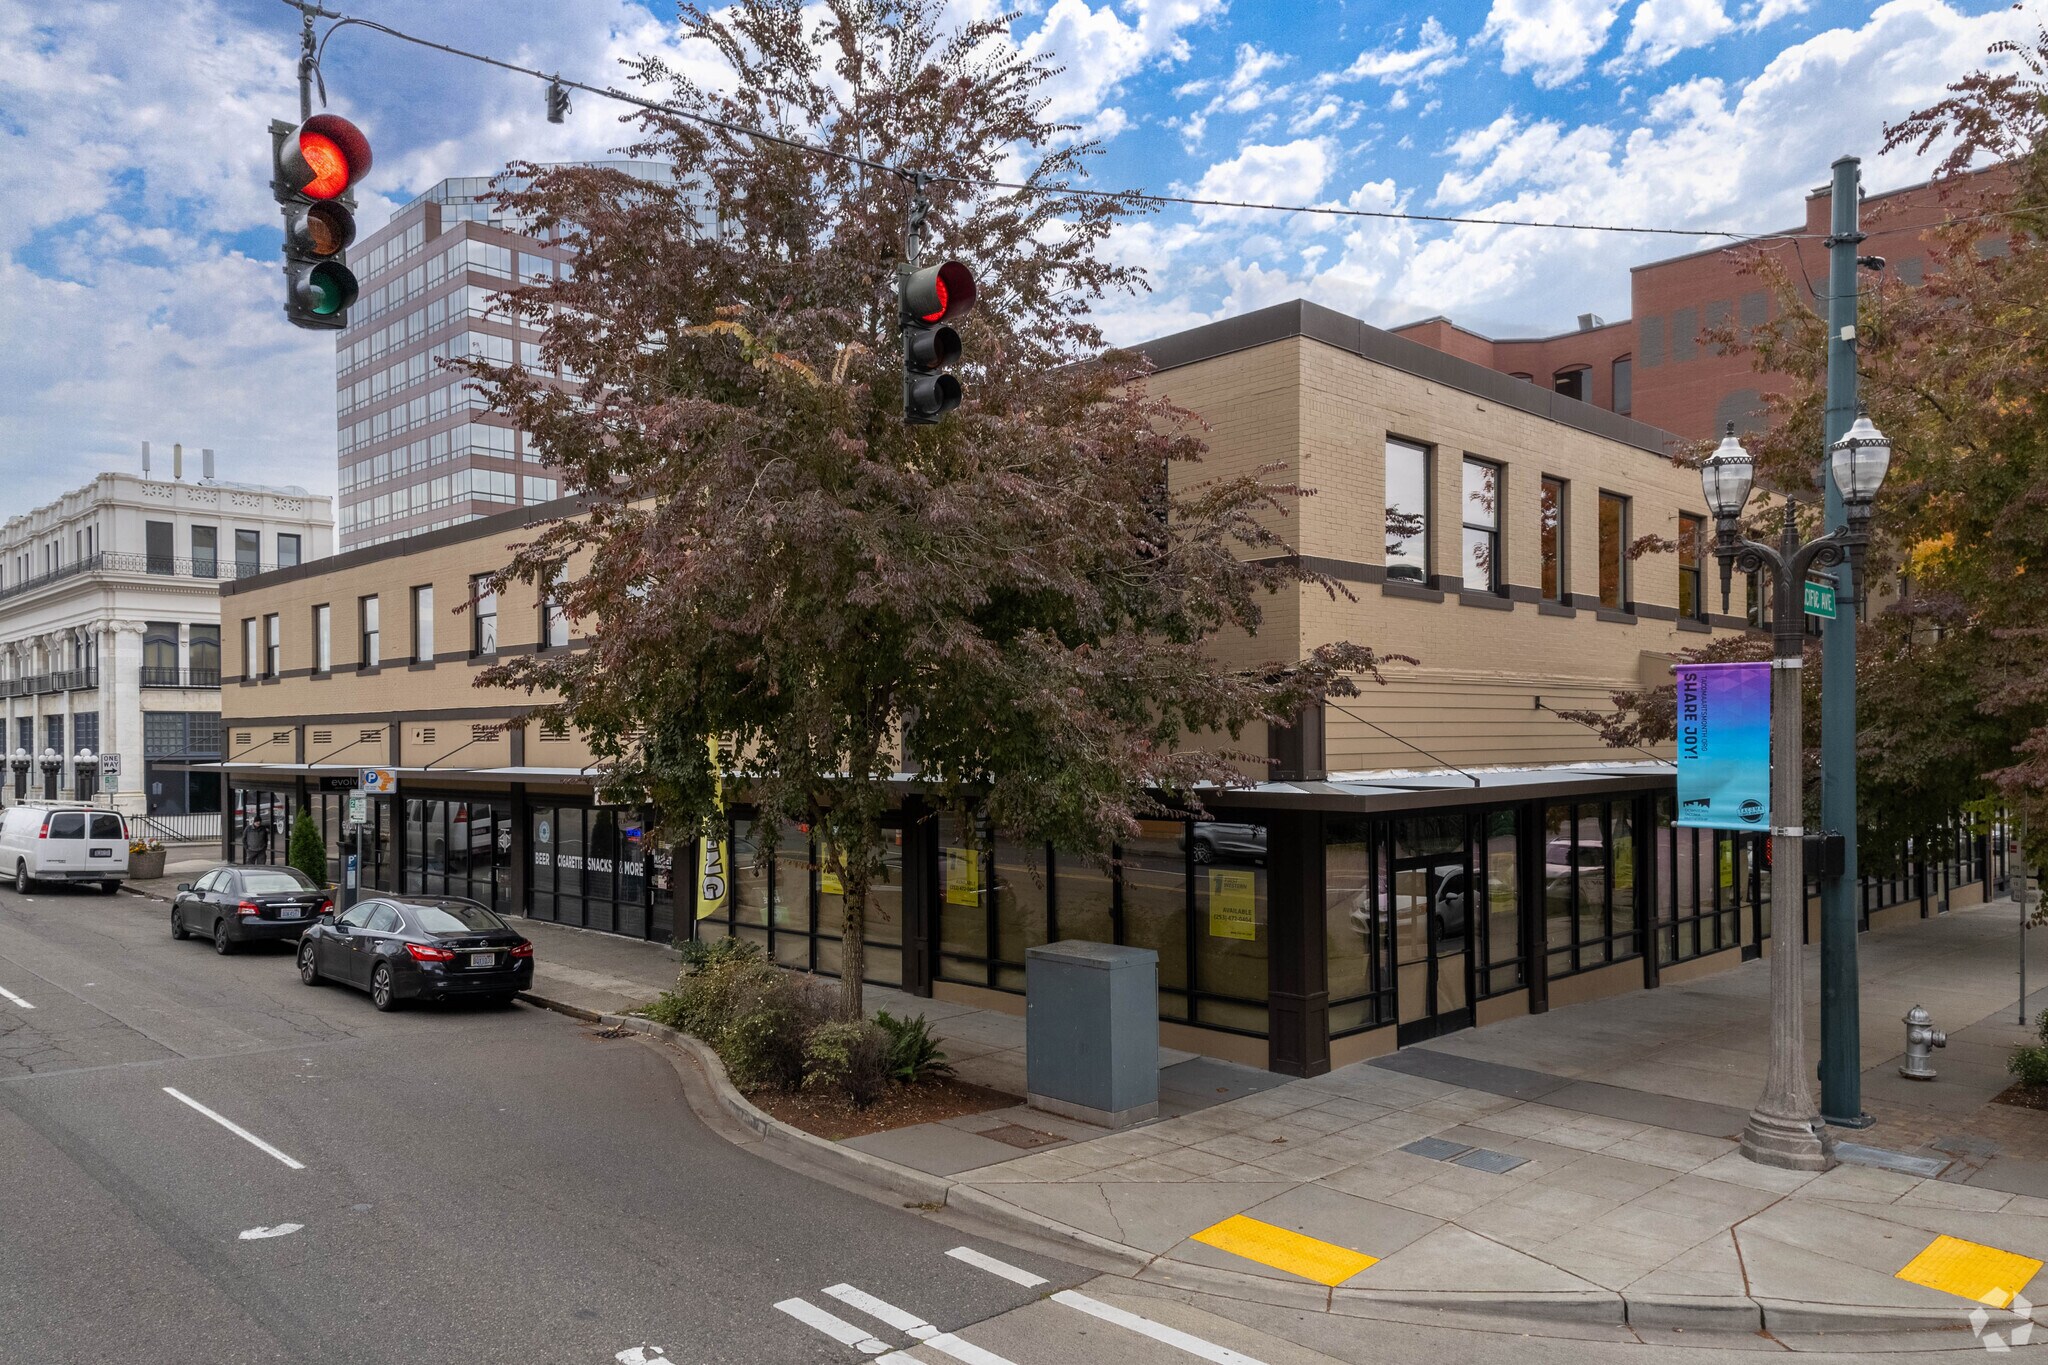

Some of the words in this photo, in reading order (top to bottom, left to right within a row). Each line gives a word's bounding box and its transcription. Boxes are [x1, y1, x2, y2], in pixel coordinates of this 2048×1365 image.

[1821, 593, 1833, 611] AVE
[1684, 673, 1698, 722] SHARE
[1684, 726, 1698, 760] JOY!
[535, 852, 550, 866] BEER
[587, 857, 612, 873] SNACKS
[618, 860, 623, 874] &
[624, 861, 644, 877] MORE
[1222, 907, 1252, 915] AVAILABLE
